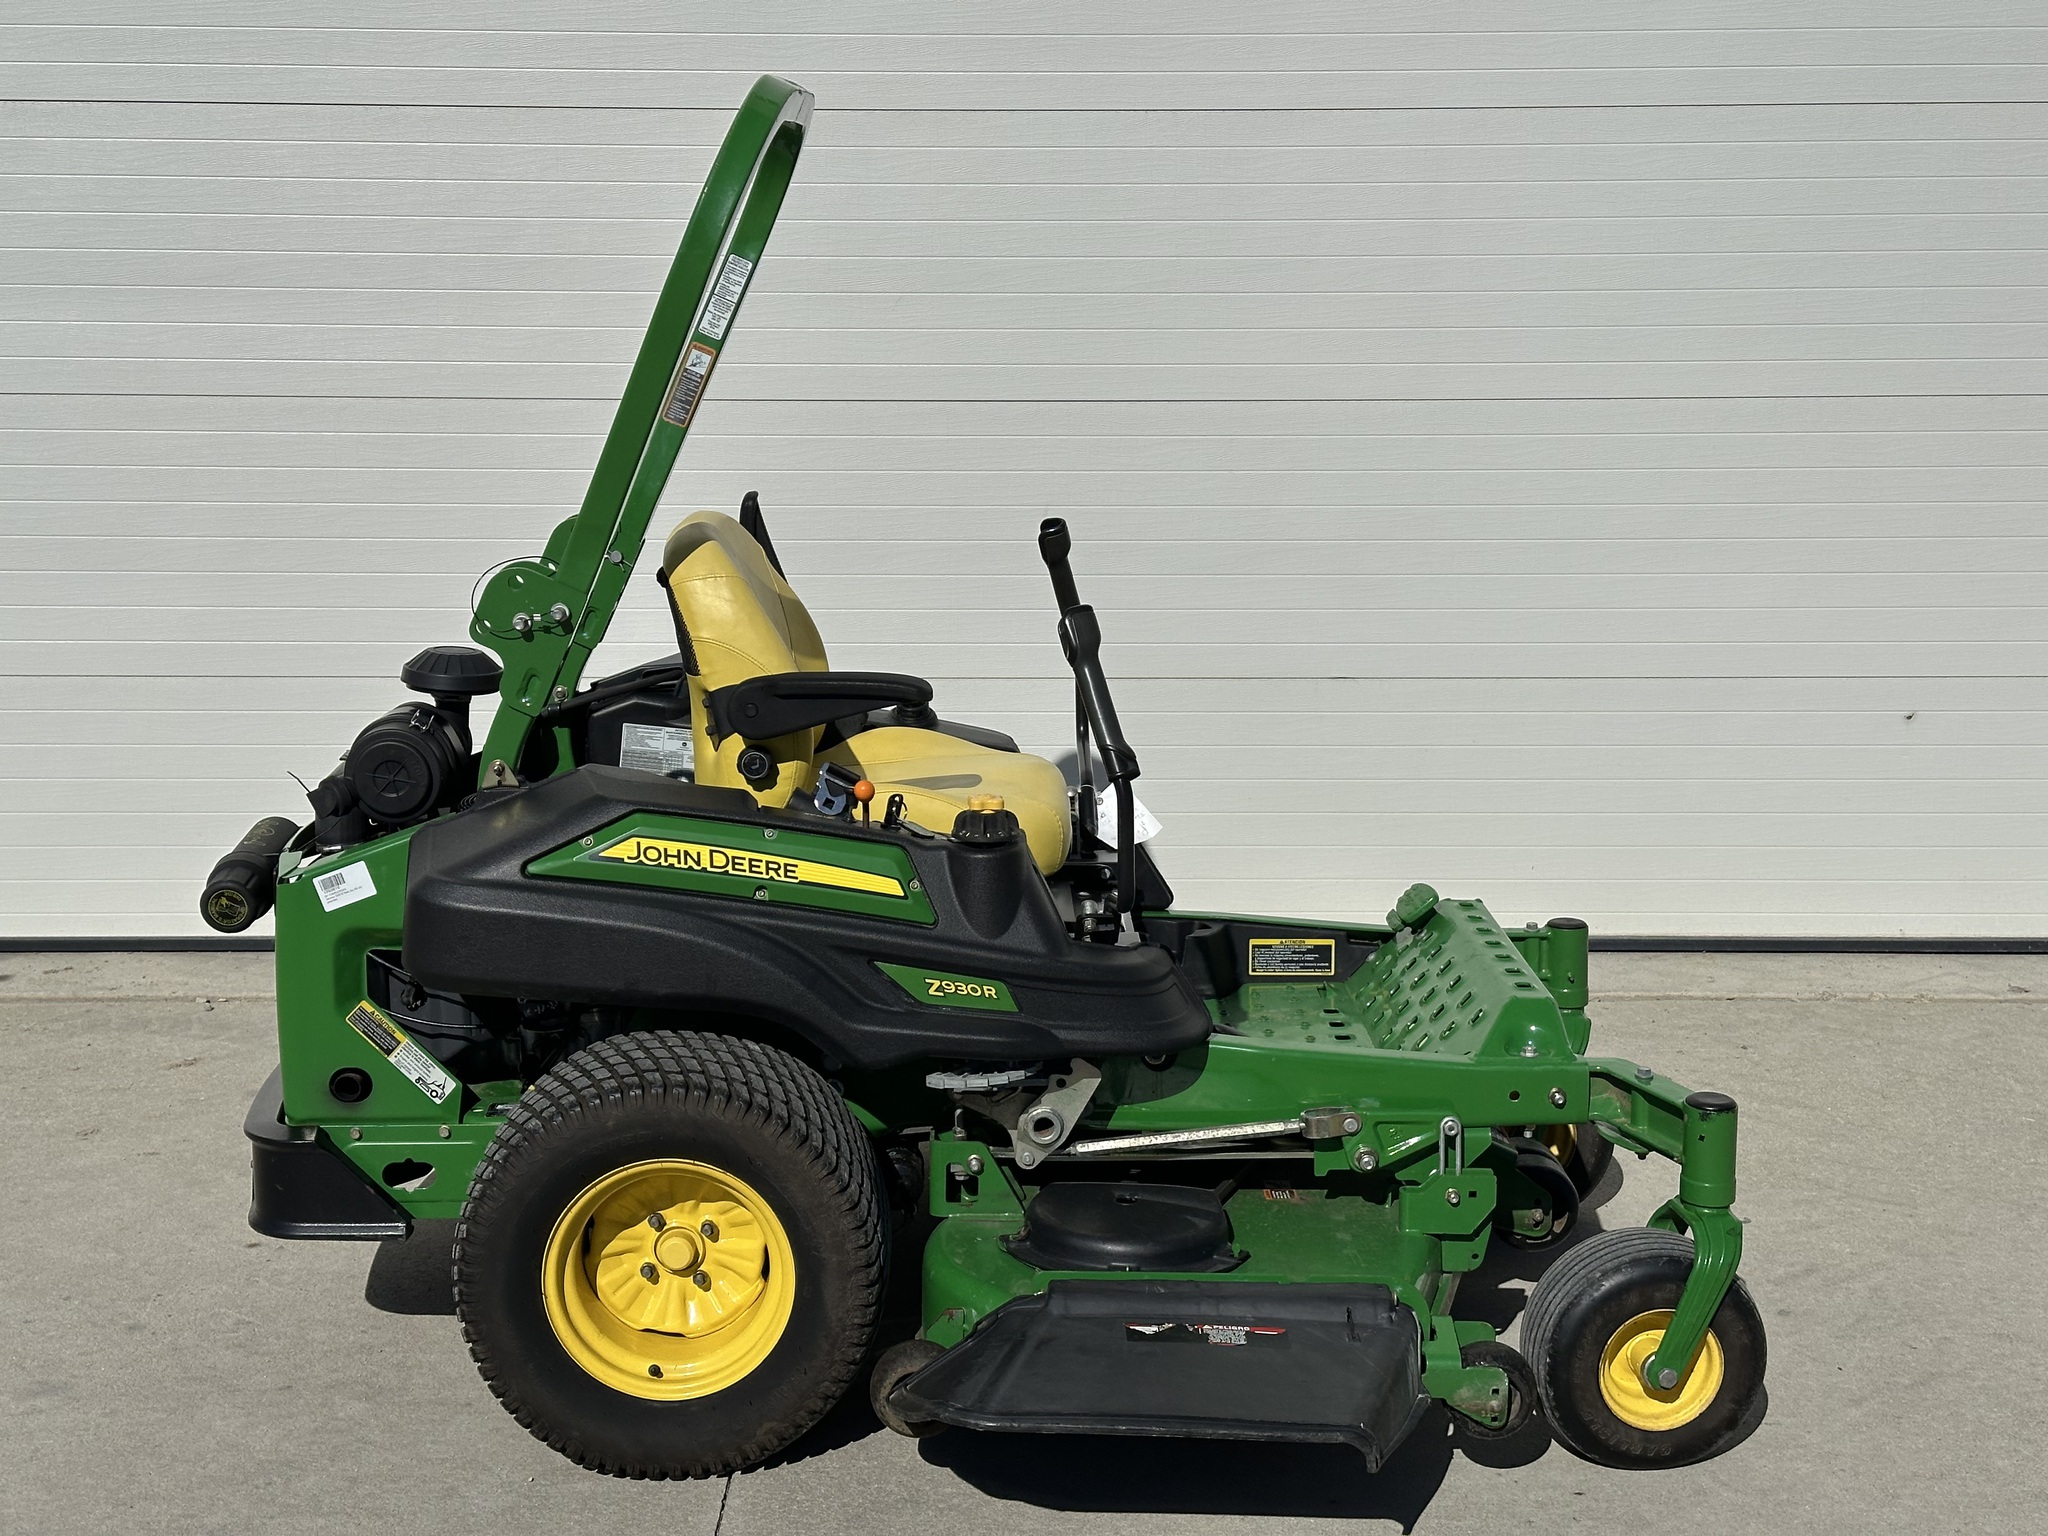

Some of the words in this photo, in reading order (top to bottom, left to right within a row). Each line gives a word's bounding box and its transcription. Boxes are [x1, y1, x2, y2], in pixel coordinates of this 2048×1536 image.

[627, 841, 701, 867] JOHN
[709, 849, 799, 880] DEERE
[925, 978, 998, 999] Z930R
[374, 1013, 397, 1036] CAUTION
[1580, 1408, 1673, 1457] CARLISLE
